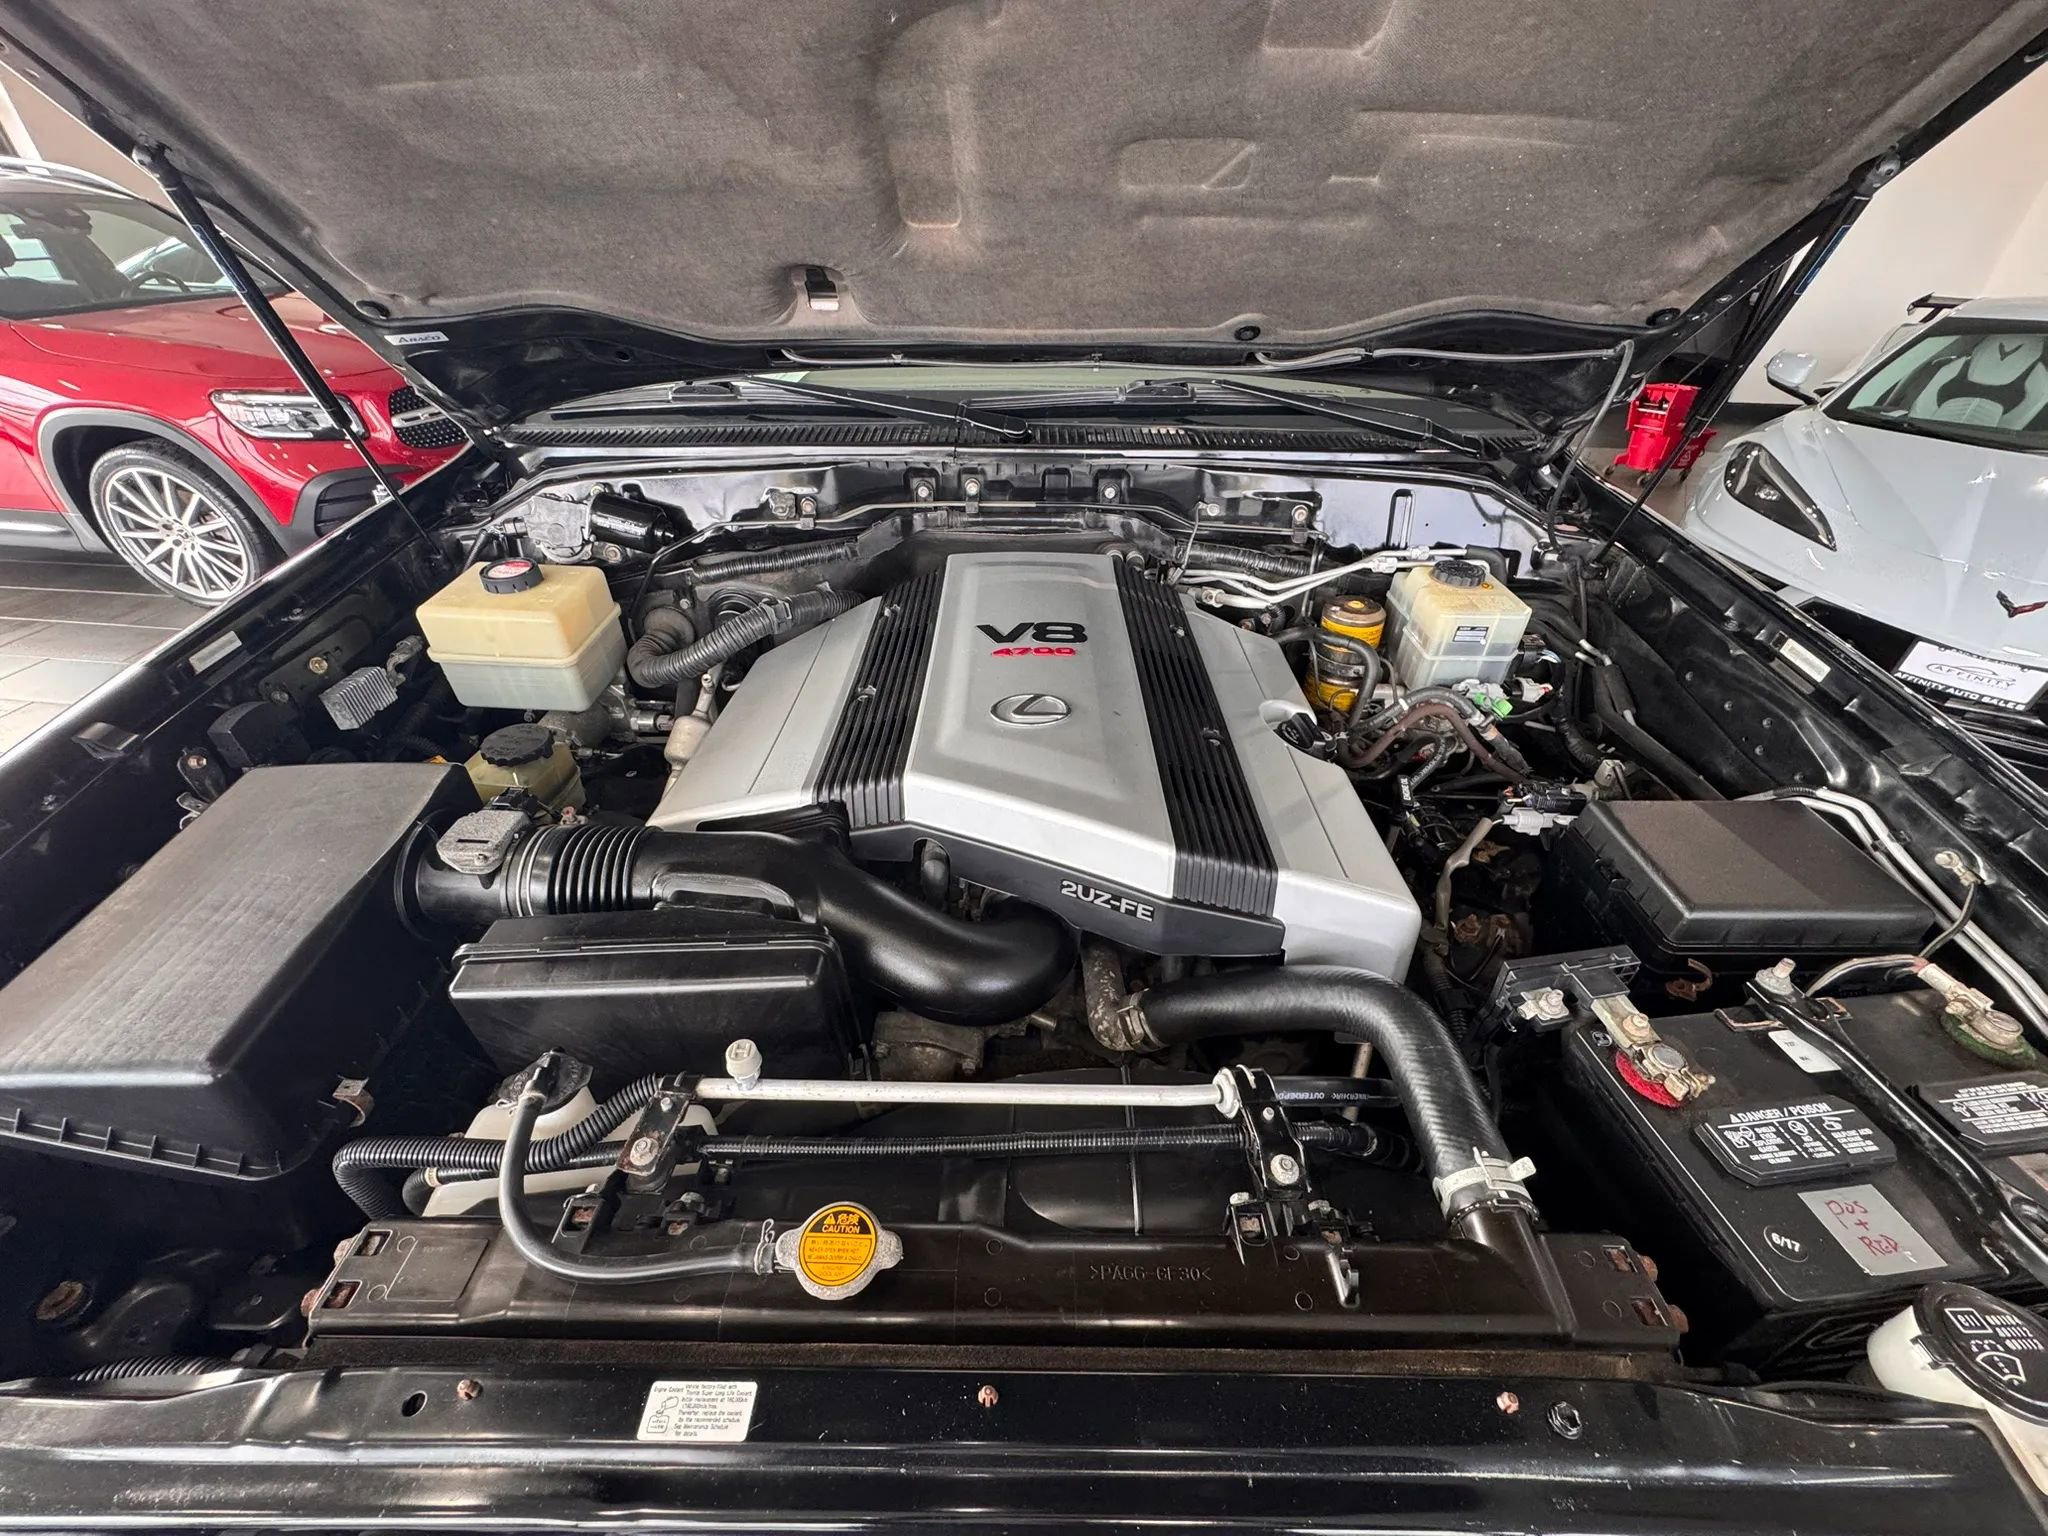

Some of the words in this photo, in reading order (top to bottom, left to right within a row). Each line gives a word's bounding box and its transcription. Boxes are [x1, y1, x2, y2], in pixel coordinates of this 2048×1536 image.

[976, 622, 1088, 644] V8
[991, 647, 1076, 657] 4700
[1893, 671, 1946, 692] AFFINITY
[1946, 685, 1980, 700] AUTO
[1980, 696, 2027, 711] SALES
[1061, 880, 1154, 922] 2UZ-FE
[1737, 1109, 1784, 1123] DANGER
[1788, 1102, 1832, 1117] POISON
[822, 1225, 860, 1234] CAUTION
[1770, 1231, 1801, 1253] 6/17
